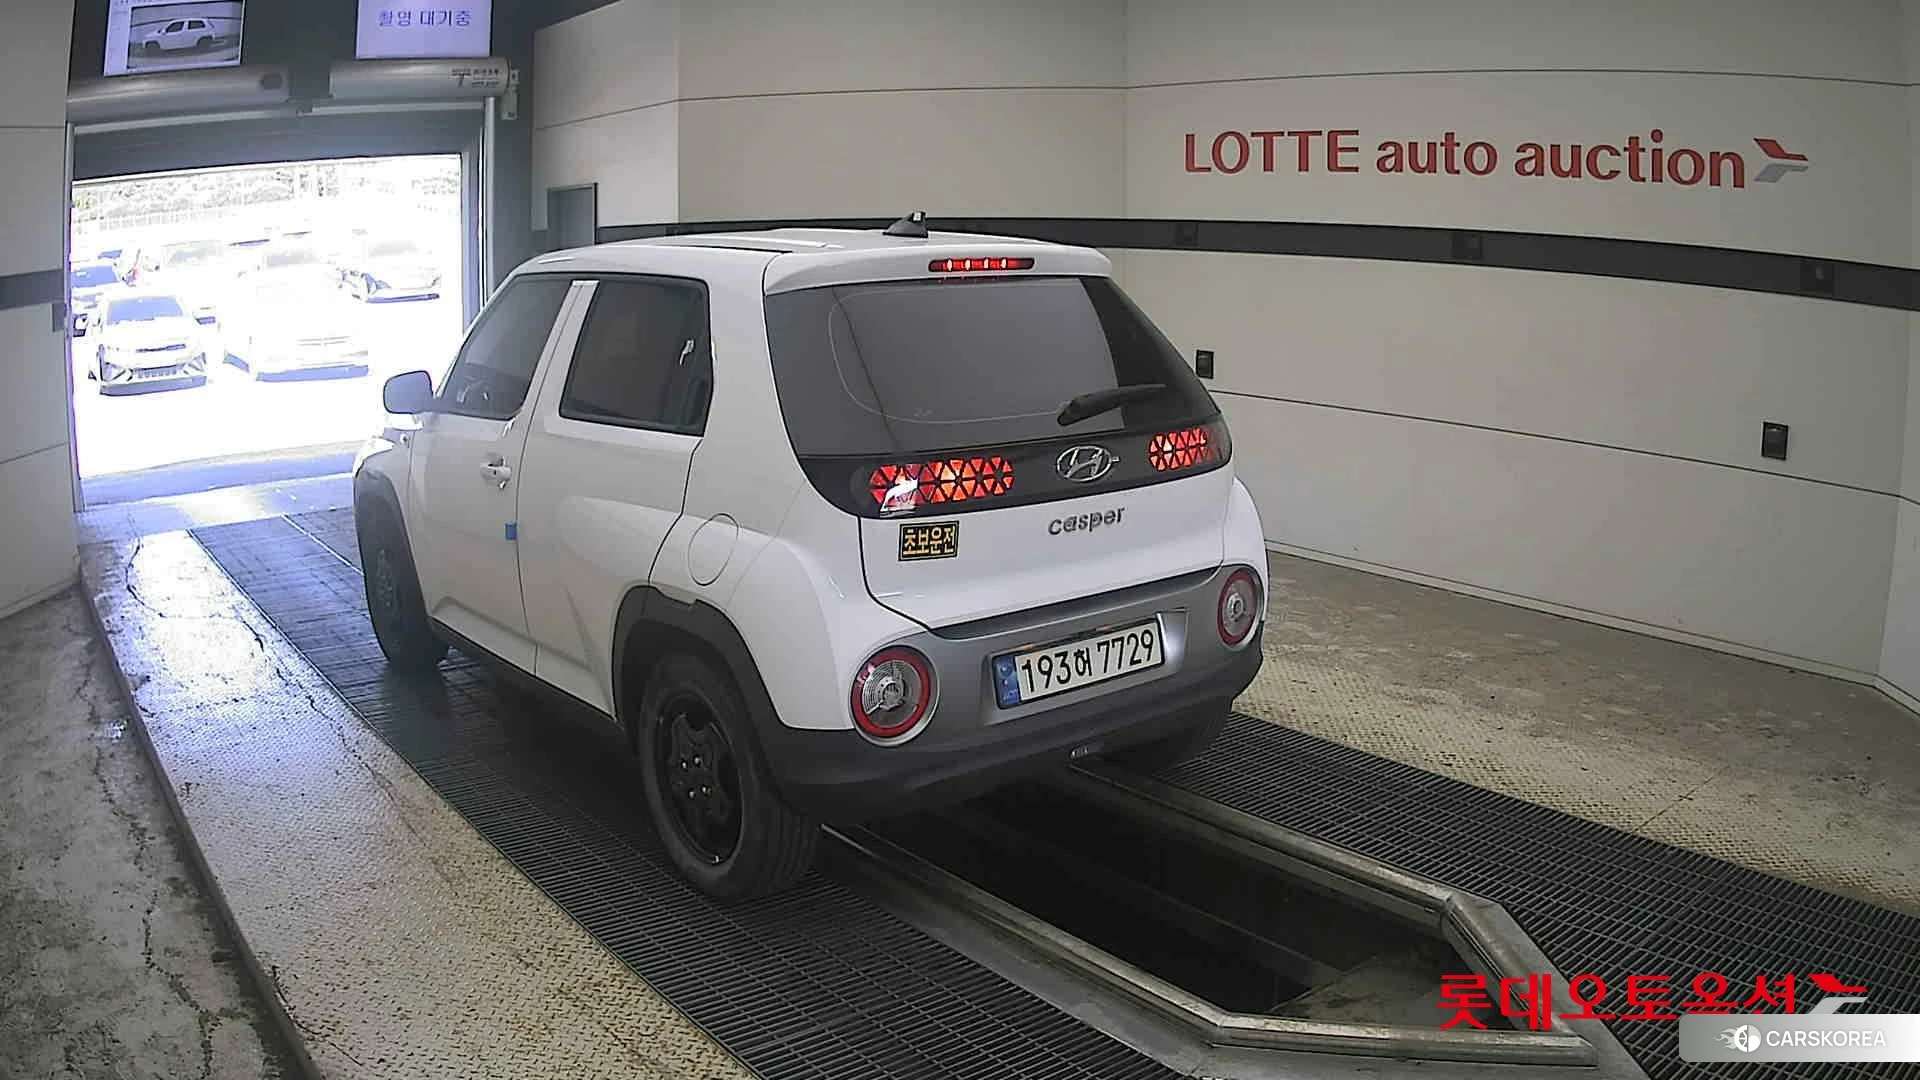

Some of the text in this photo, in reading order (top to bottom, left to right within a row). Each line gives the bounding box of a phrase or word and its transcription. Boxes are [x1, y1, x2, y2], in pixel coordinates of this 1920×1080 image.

[419, 9, 471, 27] 대기중
[1184, 129, 1746, 189] LOTTE auto auction
[1048, 507, 1125, 536] casper
[902, 525, 956, 556] 초보운전
[1021, 629, 1155, 693] 193허 7729
